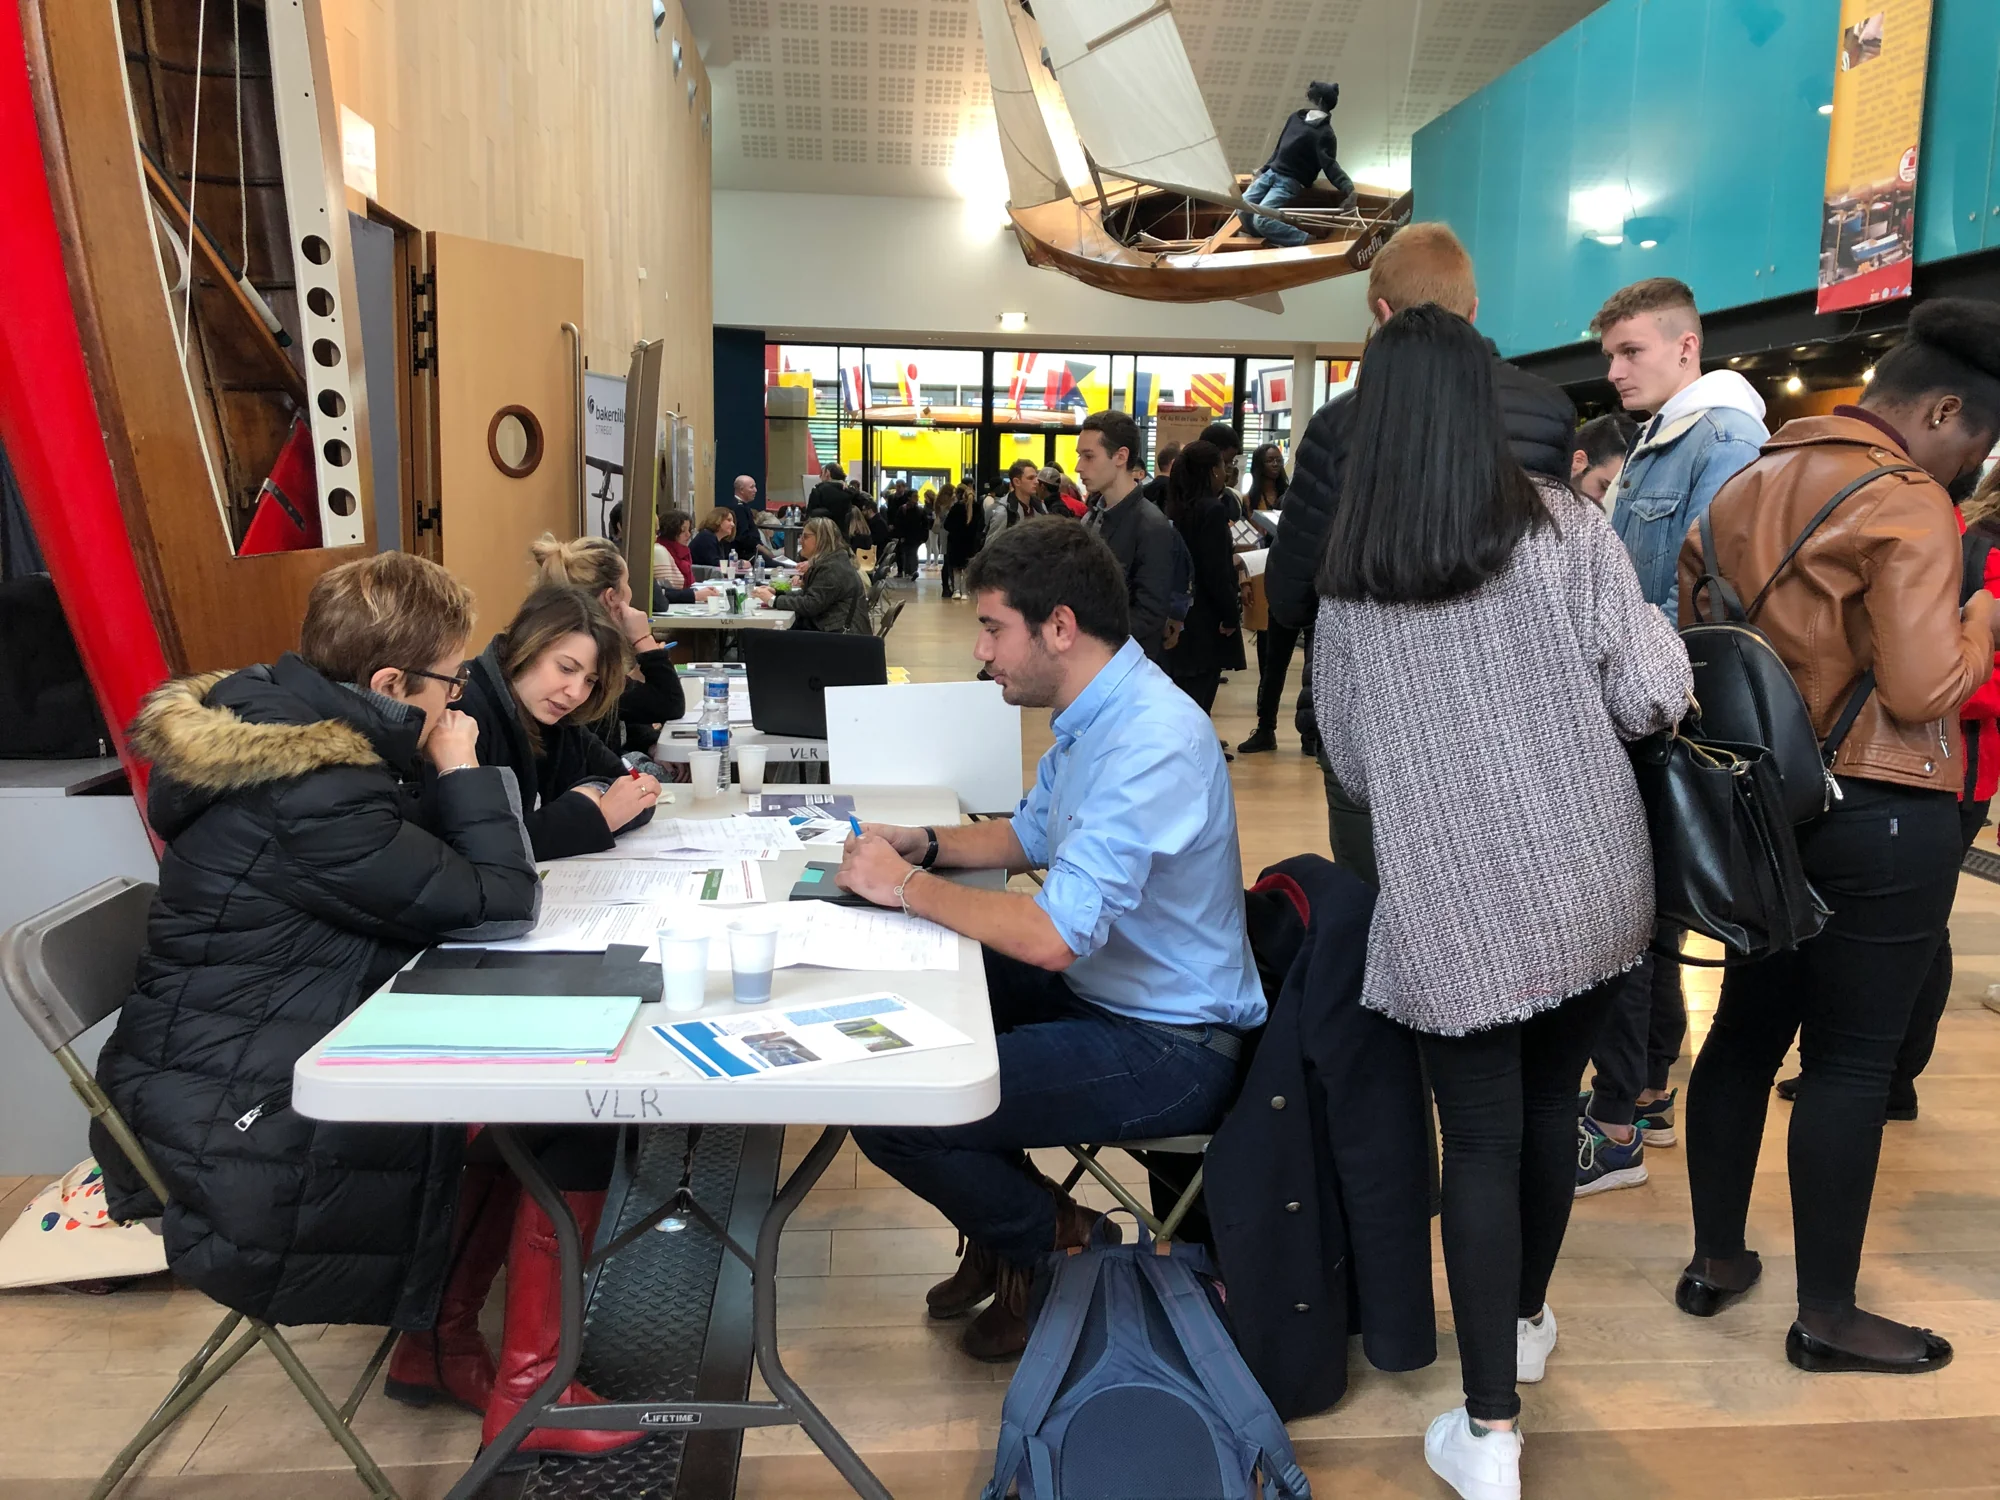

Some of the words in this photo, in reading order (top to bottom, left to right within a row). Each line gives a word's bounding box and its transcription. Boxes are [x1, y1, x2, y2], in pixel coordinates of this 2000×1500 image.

[790, 747, 819, 759] VLR
[585, 1087, 663, 1119] VLR
[645, 1413, 694, 1422] LIFETIME
